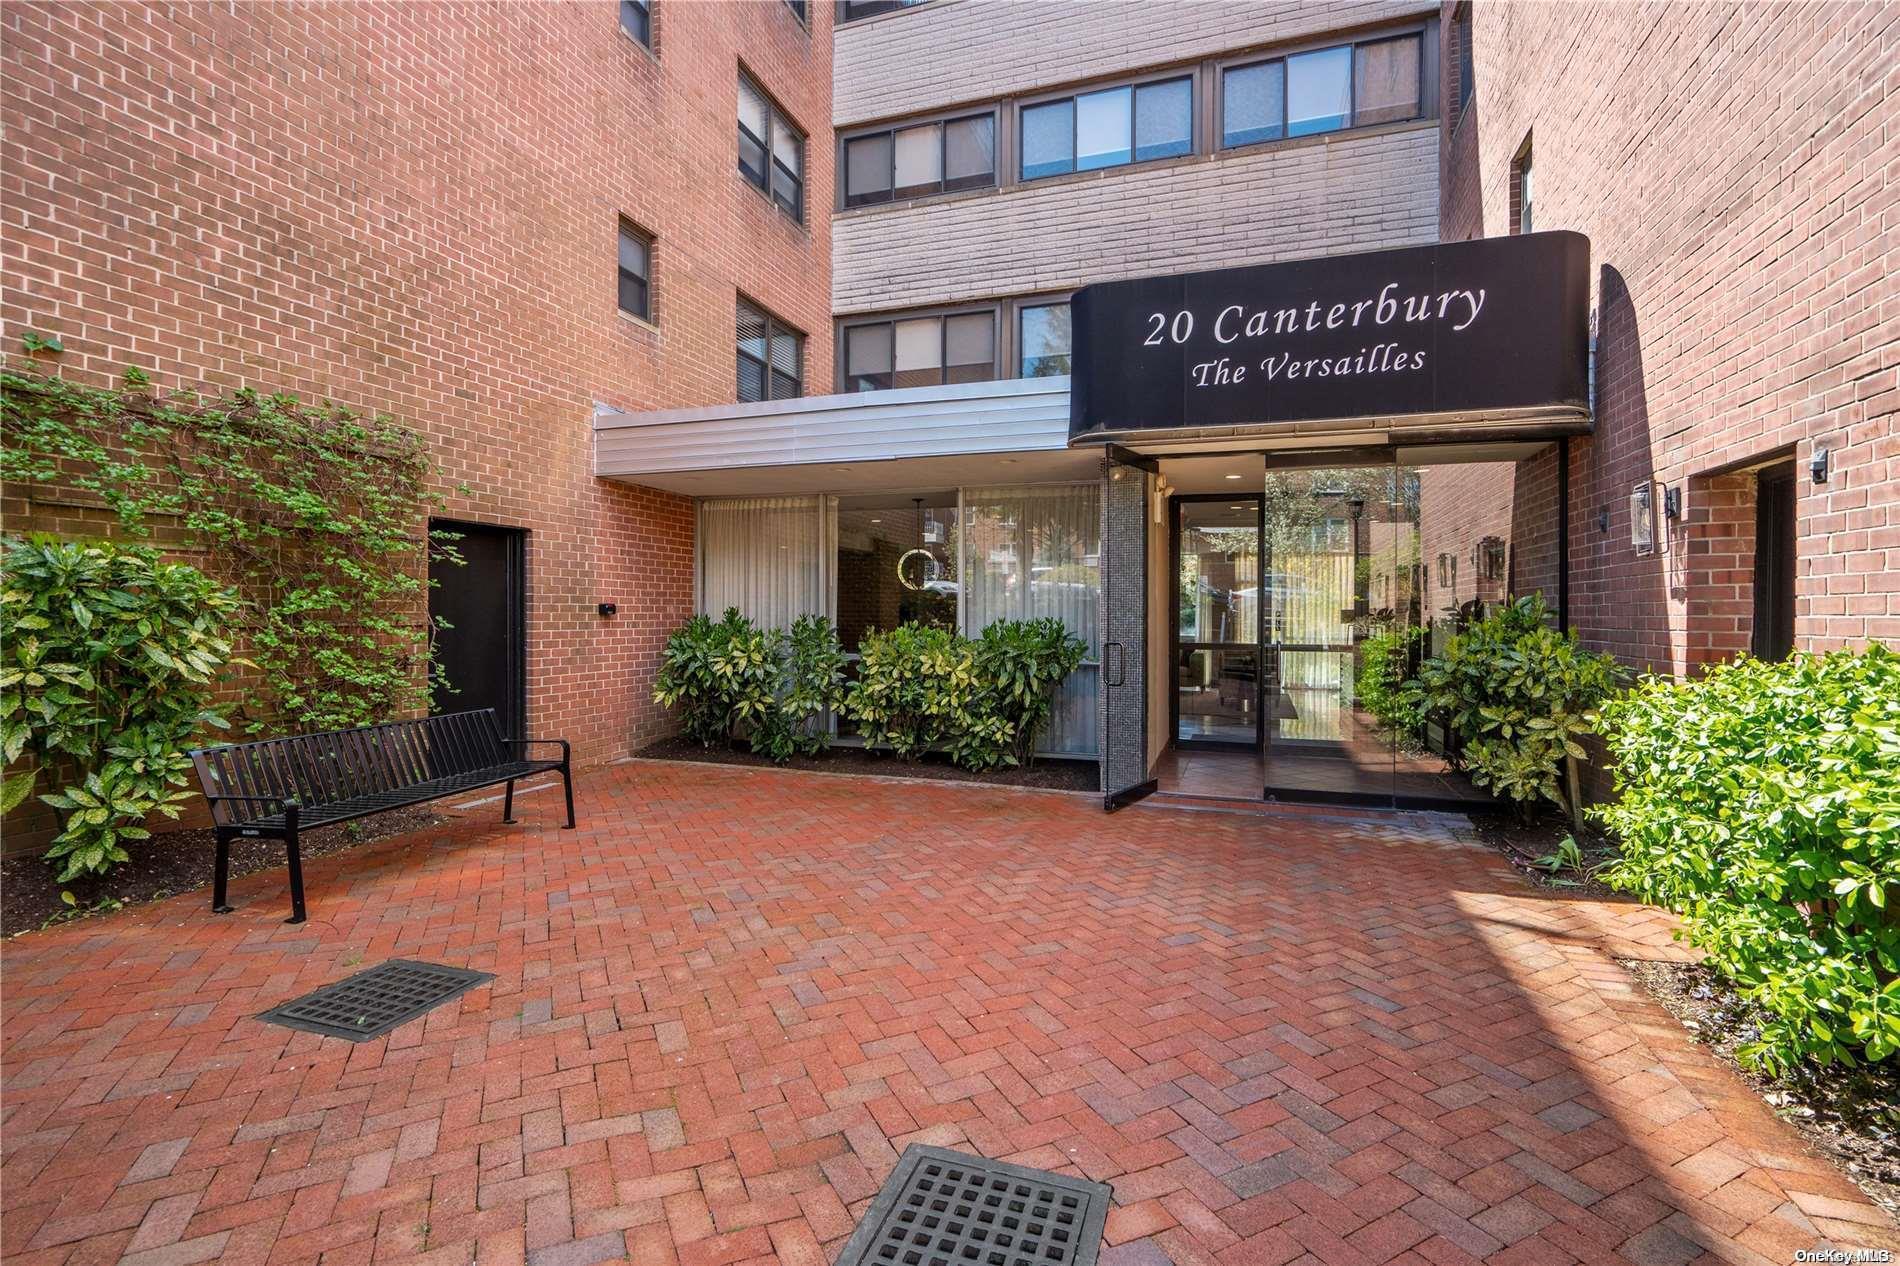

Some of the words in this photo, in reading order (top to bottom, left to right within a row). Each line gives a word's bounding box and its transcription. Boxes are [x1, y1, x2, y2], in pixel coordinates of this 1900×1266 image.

[1143, 310, 1195, 346] 20
[1213, 282, 1487, 344] Canterbury
[1192, 357, 1246, 387] The
[1260, 342, 1426, 380] Versailles
